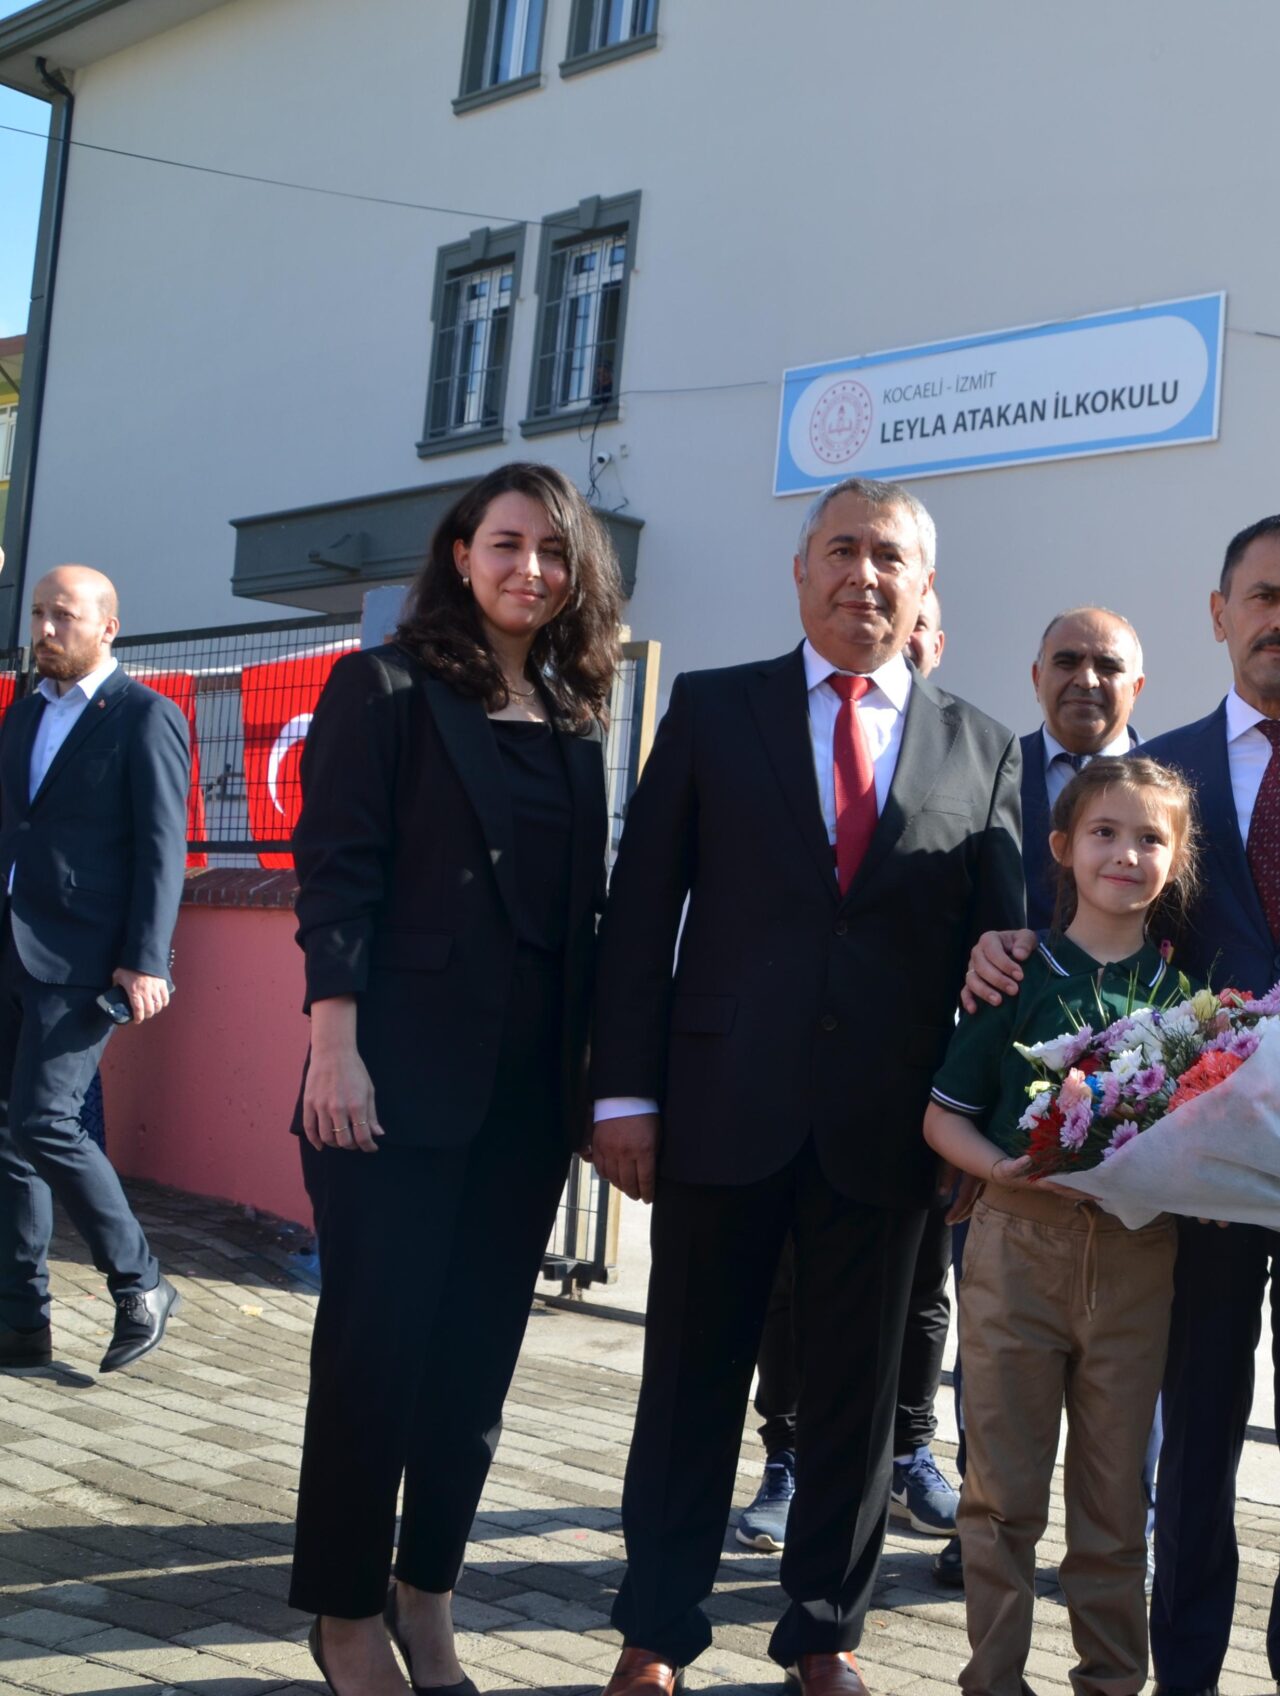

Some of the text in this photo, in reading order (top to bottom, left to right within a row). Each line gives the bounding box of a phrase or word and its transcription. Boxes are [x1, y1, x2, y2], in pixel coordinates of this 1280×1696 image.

[880, 416, 947, 444] LEYLA
[953, 399, 1047, 433] ATAKAN
[1053, 380, 1179, 419] İLKOKULU
[883, 376, 944, 405] KOCAELİ
[955, 371, 997, 394] İZMİT
